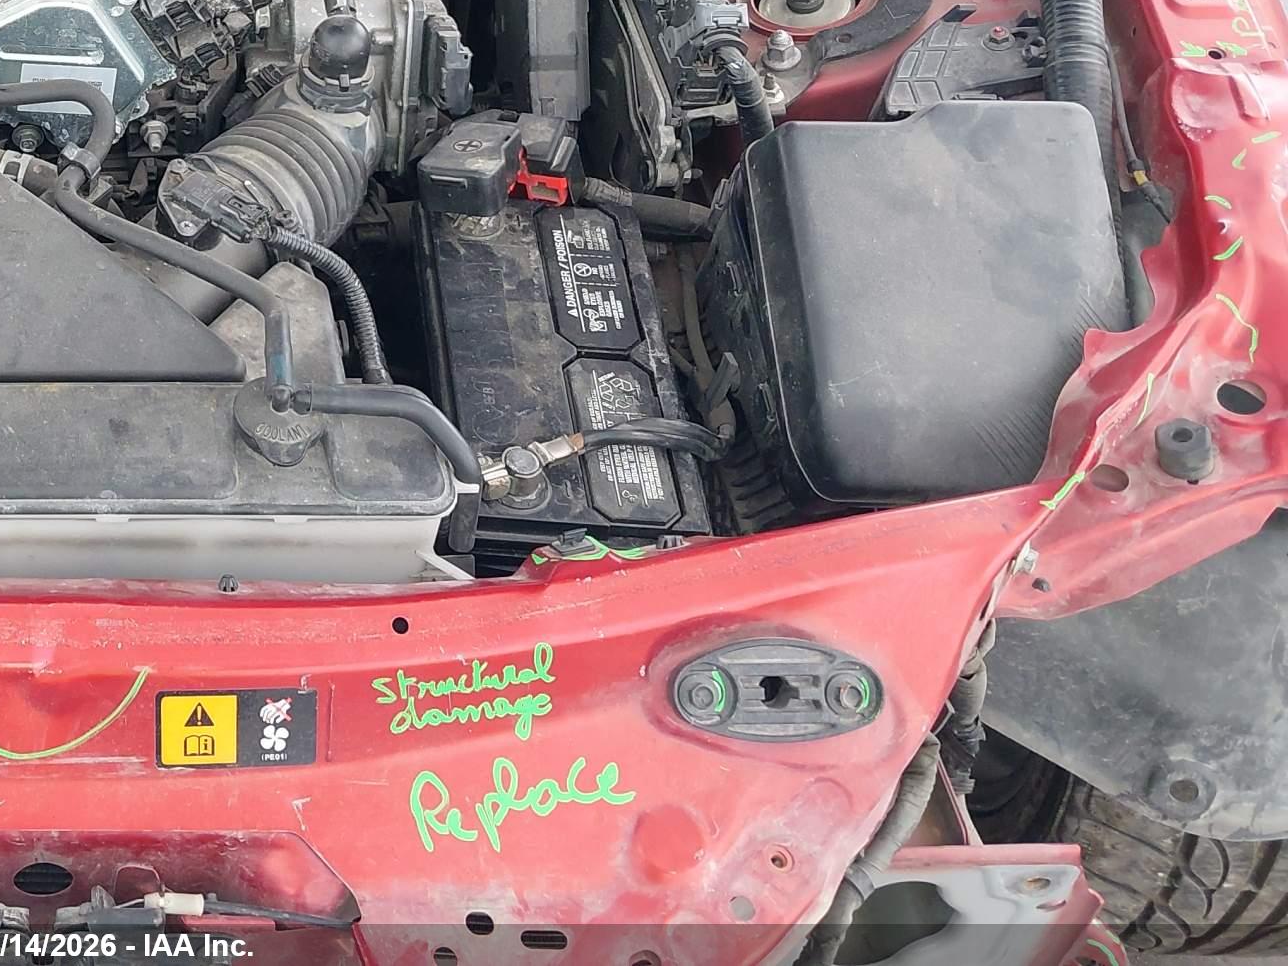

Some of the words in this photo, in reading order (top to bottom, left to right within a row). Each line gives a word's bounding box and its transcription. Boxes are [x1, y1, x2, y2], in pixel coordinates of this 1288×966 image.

[552, 229, 567, 262] POISON
[560, 270, 578, 308] DANGER
[390, 694, 553, 740] damage
[410, 757, 637, 853] Replace
